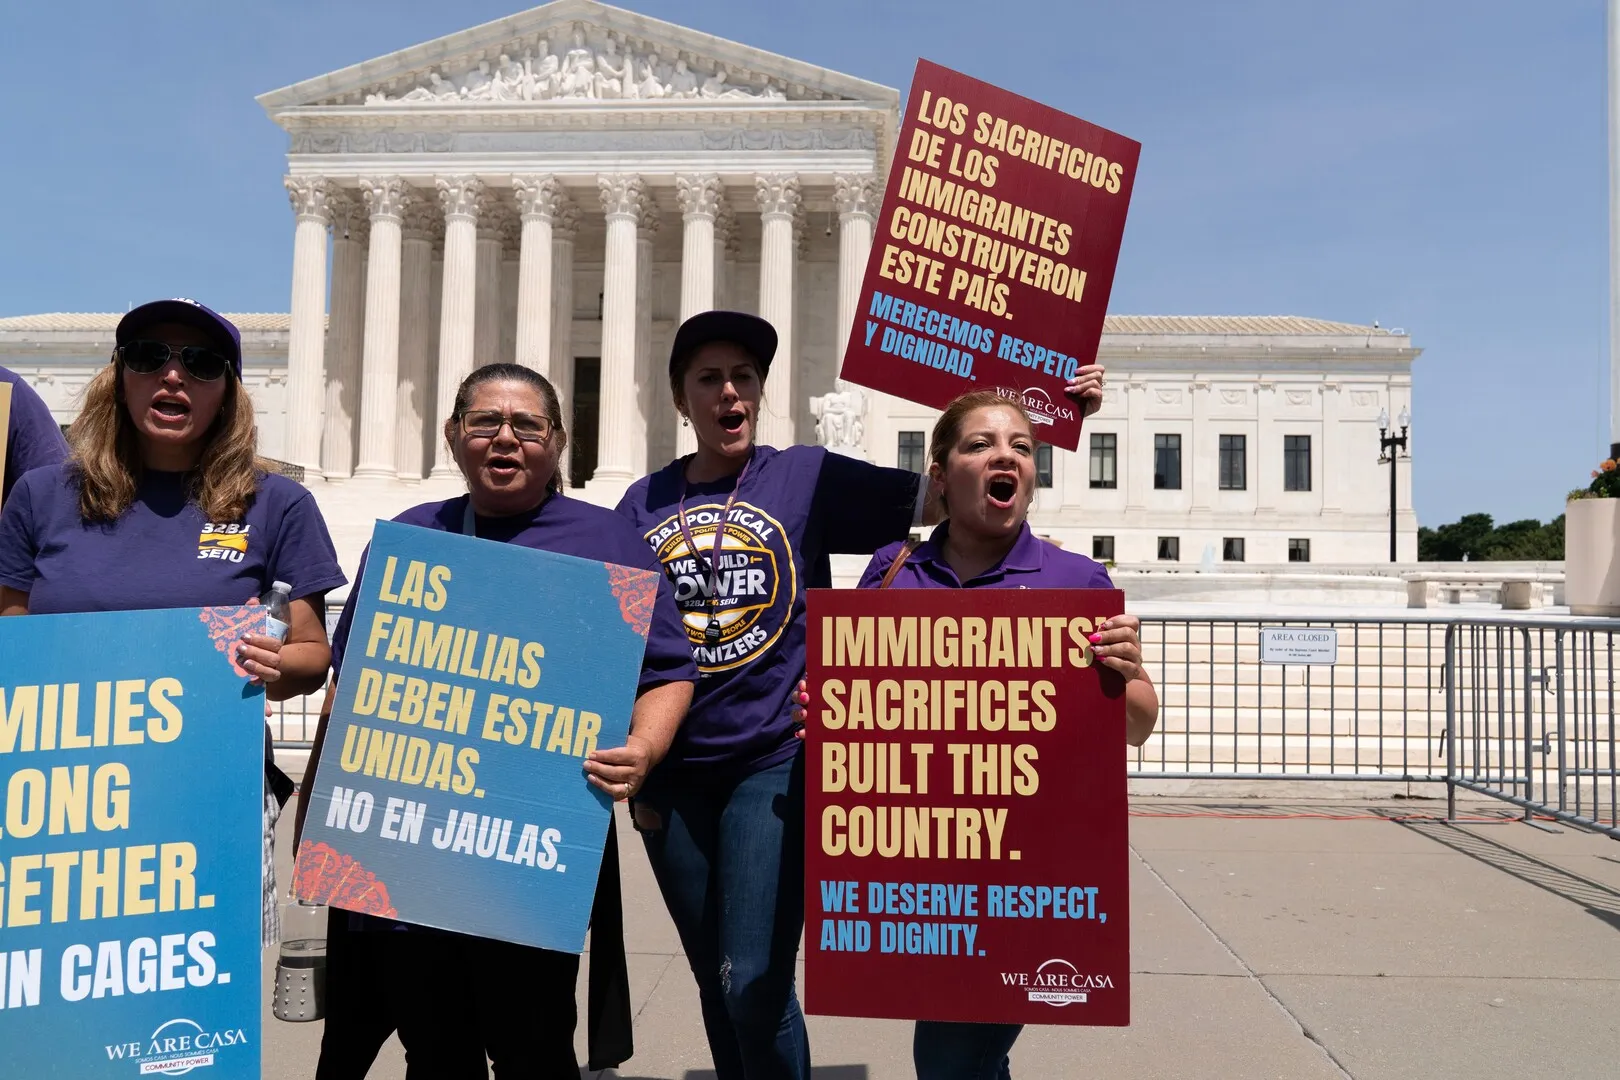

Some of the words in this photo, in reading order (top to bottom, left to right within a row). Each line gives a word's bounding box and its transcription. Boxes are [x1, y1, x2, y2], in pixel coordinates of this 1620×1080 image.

[908, 127, 946, 169] DE
[949, 141, 1000, 188] LOS
[918, 90, 969, 136] LOS
[974, 111, 1124, 194] SACRIFICIOS
[898, 166, 1073, 256] INMIGRANTES
[890, 206, 1088, 303] CONSTRUYERON
[879, 244, 946, 295] ESTE
[948, 269, 1013, 320] PAÍS.
[864, 320, 878, 347] Y
[880, 326, 977, 381] DIGNIDAD.
[869, 291, 994, 353] MERECEMOS
[997, 333, 1079, 381] RESPETO
[996, 386, 1016, 402] WE
[1019, 395, 1044, 410] ARE
[1045, 403, 1074, 421] CASA
[201, 523, 251, 534] 32BJ
[650, 521, 681, 553] 2BJ
[685, 509, 774, 542] POLTICAL
[728, 528, 752, 544] POWER
[197, 549, 245, 563] SEIU
[669, 559, 697, 575] WE
[379, 555, 452, 612] LAS
[720, 598, 738, 606] SEIU
[365, 612, 545, 689] FAMILIAS
[722, 619, 747, 636] PEOPLE
[1298, 634, 1329, 642] CLOSED
[353, 668, 478, 734] DEBEN
[482, 693, 602, 758] ESTAR
[821, 679, 1057, 732] SACRIFICES
[340, 725, 486, 798] UNIDAS.
[822, 742, 934, 794] BUILT
[948, 743, 1040, 796] THIS
[0, 762, 131, 840] ONG
[325, 786, 375, 833] NO
[380, 797, 427, 845] EN
[432, 808, 567, 872] JAULAS.
[821, 805, 1021, 860] COUNTRY.
[0, 842, 216, 928] ETHER.
[820, 880, 859, 914] WE
[868, 882, 978, 917] DESERVE
[988, 886, 1107, 923] RESPECT,
[820, 919, 871, 953] AND
[880, 921, 986, 957] DIGNITY.
[60, 930, 231, 1003] CAGES.
[1000, 972, 1029, 986] WE
[1033, 973, 1068, 987] ARE
[1071, 974, 1115, 989] CASA
[105, 1042, 141, 1060] WE
[146, 1035, 190, 1055] ARE
[195, 1029, 247, 1049] CASA
[135, 1055, 153, 1064] SOMOS
[154, 1054, 168, 1062] CASA
[184, 1050, 205, 1058] SOMMES
[144, 1060, 185, 1072] COMMUNITY
[186, 1057, 209, 1066] POWER
